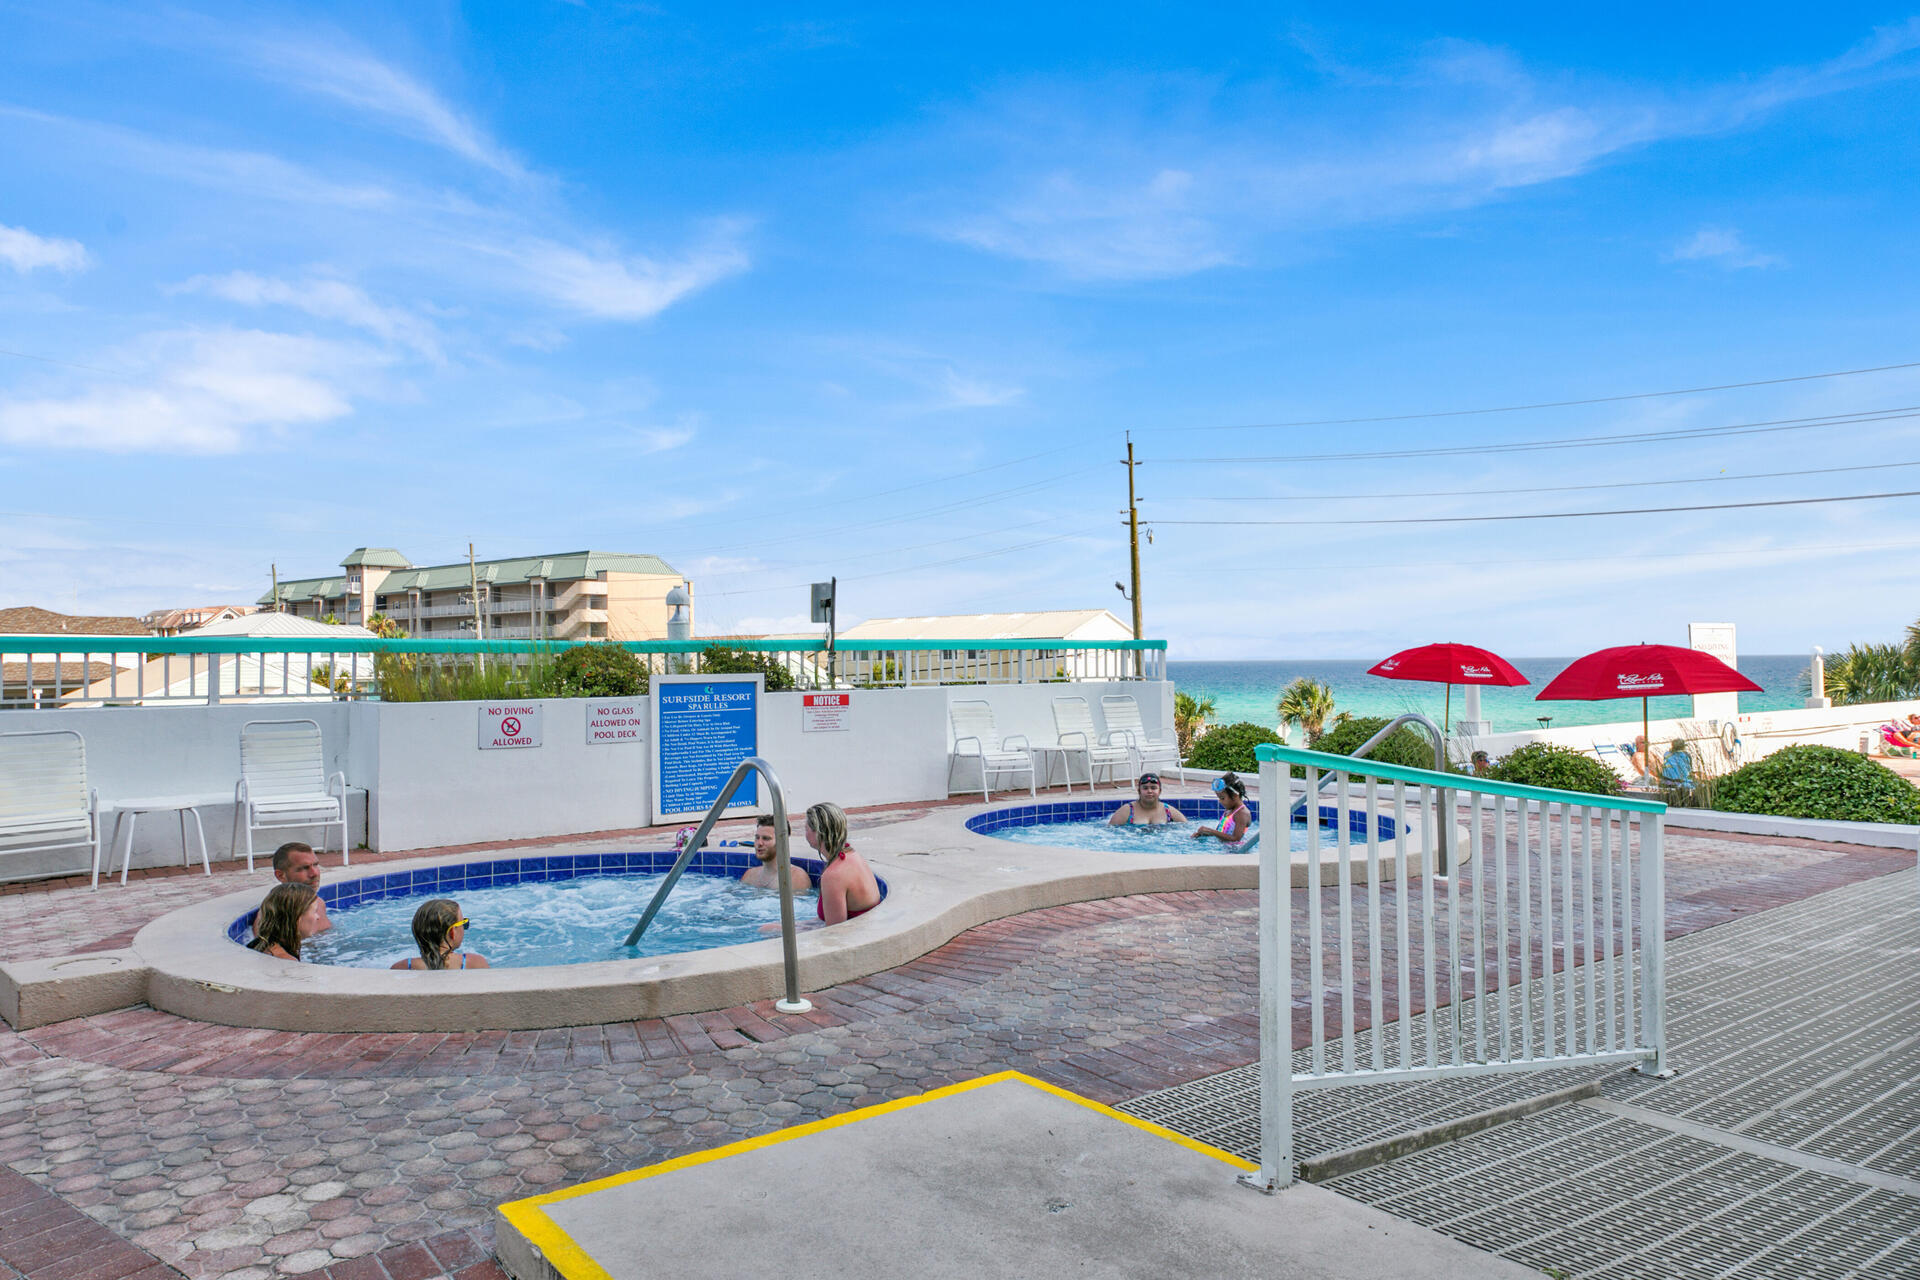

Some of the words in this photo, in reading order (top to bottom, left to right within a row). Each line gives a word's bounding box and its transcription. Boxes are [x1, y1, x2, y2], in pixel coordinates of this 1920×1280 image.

[663, 695, 711, 704] SURFSIDE
[713, 693, 751, 702] RESORT
[813, 696, 840, 705] NOTICE
[688, 703, 702, 711] SPA
[703, 702, 728, 710] RULES
[488, 708, 502, 716] NO
[504, 707, 534, 715] DIVING
[597, 708, 610, 716] NO
[611, 707, 634, 715] GLASS
[590, 719, 627, 727] ALLOWED
[628, 718, 641, 726] ON
[594, 731, 615, 739] POOL
[617, 730, 637, 738] DECK
[492, 737, 532, 746] ALLOWED
